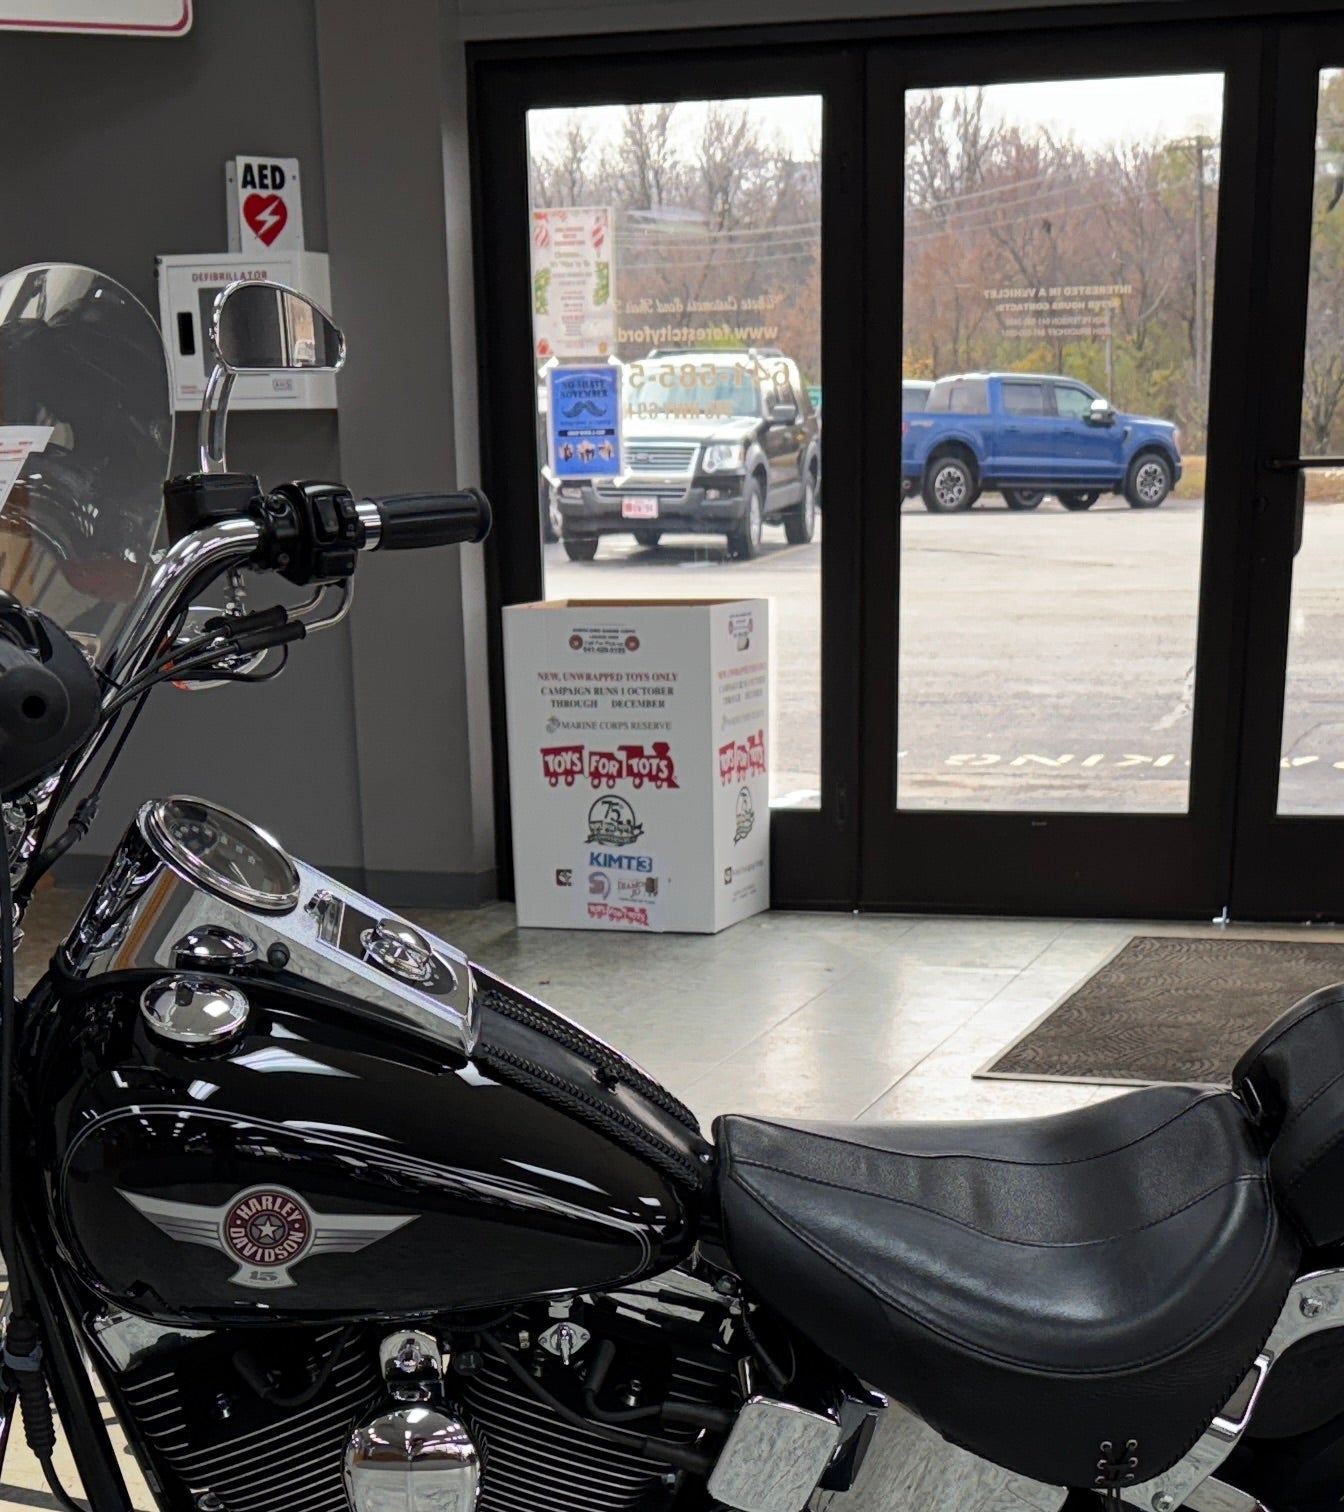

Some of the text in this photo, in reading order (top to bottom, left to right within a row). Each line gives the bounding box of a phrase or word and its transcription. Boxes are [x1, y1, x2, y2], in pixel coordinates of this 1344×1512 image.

[241, 163, 286, 190] AED
[191, 270, 268, 283] DEFIBRILLATOR
[537, 672, 679, 683] NEW, UNWRAPPED TOYS ONLY
[540, 686, 592, 696] CAMPAIGN
[593, 686, 619, 696] RUNS
[626, 686, 674, 696] OCTOBER
[550, 699, 666, 709] THROUGH DECEMBER
[561, 720, 672, 731] MARINE CORPS RESERVE
[544, 750, 669, 779] TOYS FOR TOTS
[235, 1194, 302, 1222] HARLEY
[229, 1226, 306, 1263] DAVIDSON
[248, 1270, 279, 1283] 15
